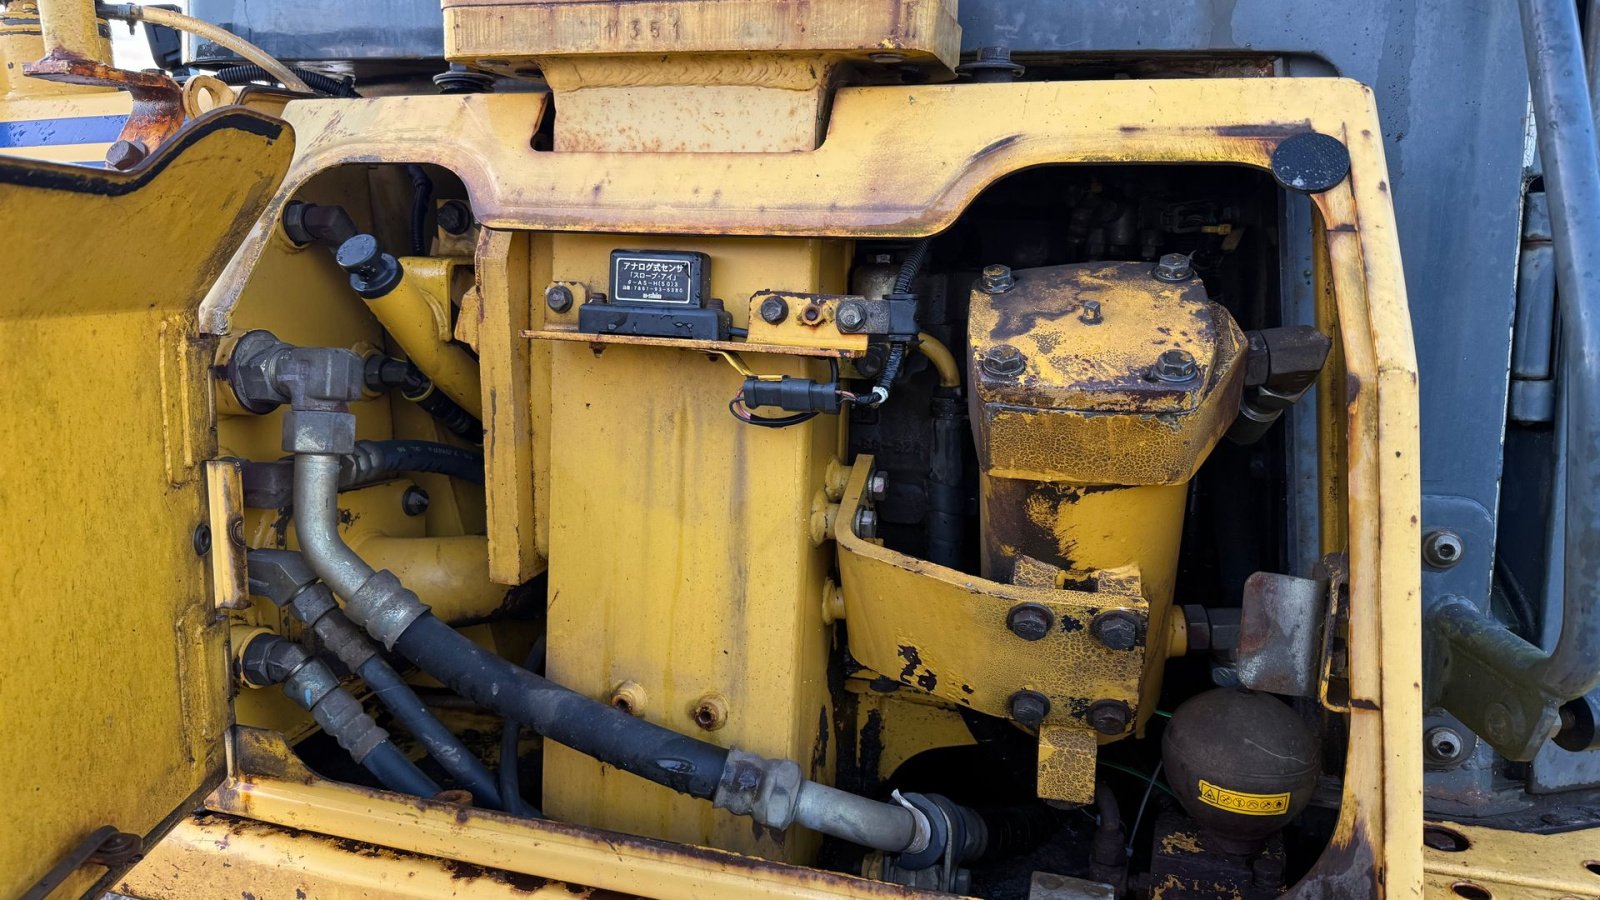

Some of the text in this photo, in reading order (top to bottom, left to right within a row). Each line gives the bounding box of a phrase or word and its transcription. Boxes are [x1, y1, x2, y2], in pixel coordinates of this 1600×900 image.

[623, 262, 684, 273] アナログ式センサ
